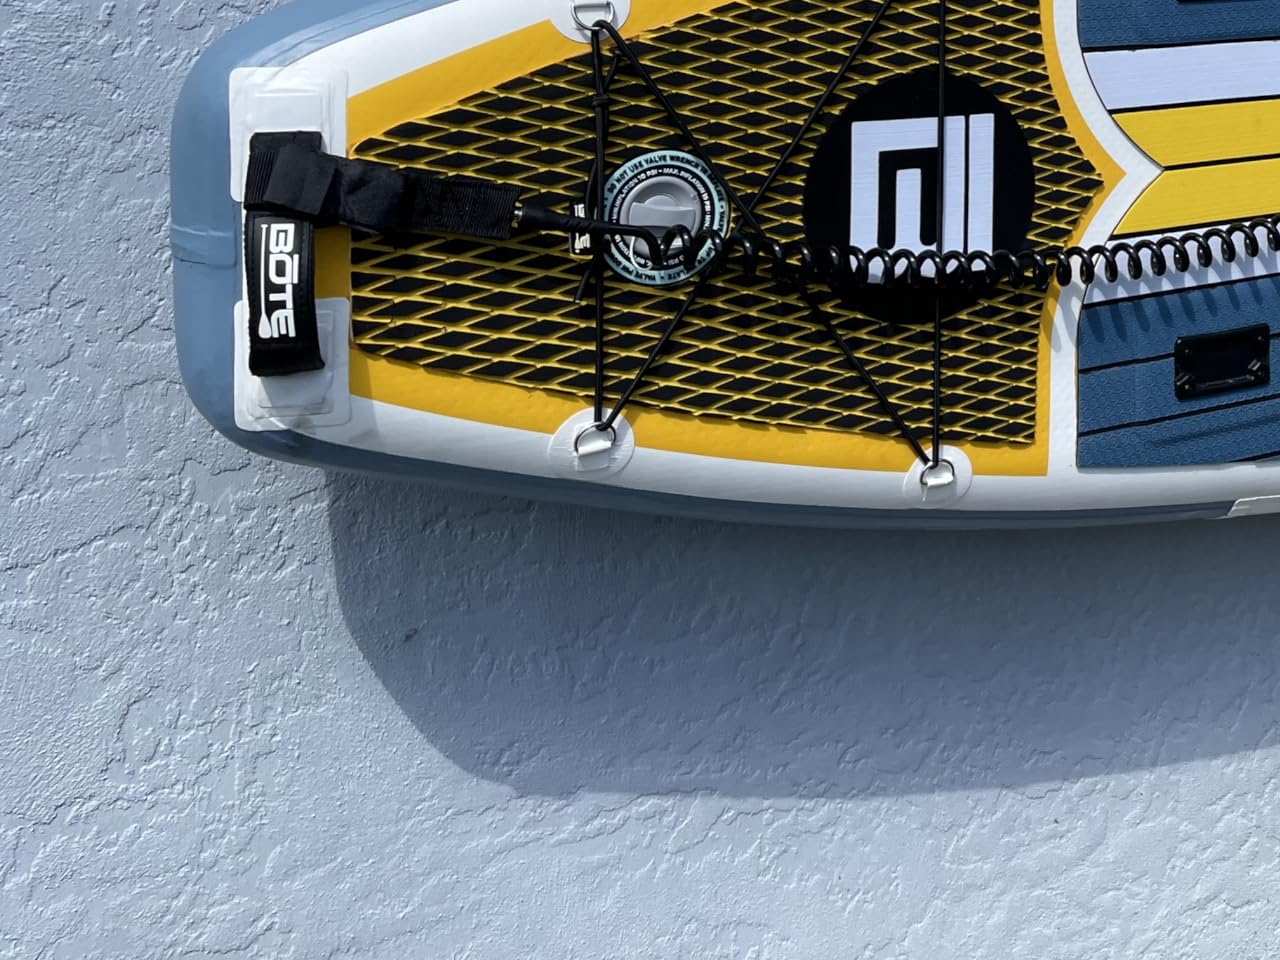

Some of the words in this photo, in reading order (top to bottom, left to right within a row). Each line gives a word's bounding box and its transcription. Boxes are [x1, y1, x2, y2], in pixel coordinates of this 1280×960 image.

[607, 183, 618, 194] DO
[614, 170, 629, 185] NOT
[628, 161, 644, 173] USE
[644, 154, 667, 165] VALVE
[669, 154, 700, 170] WRENCH
[646, 169, 658, 177] PSI
